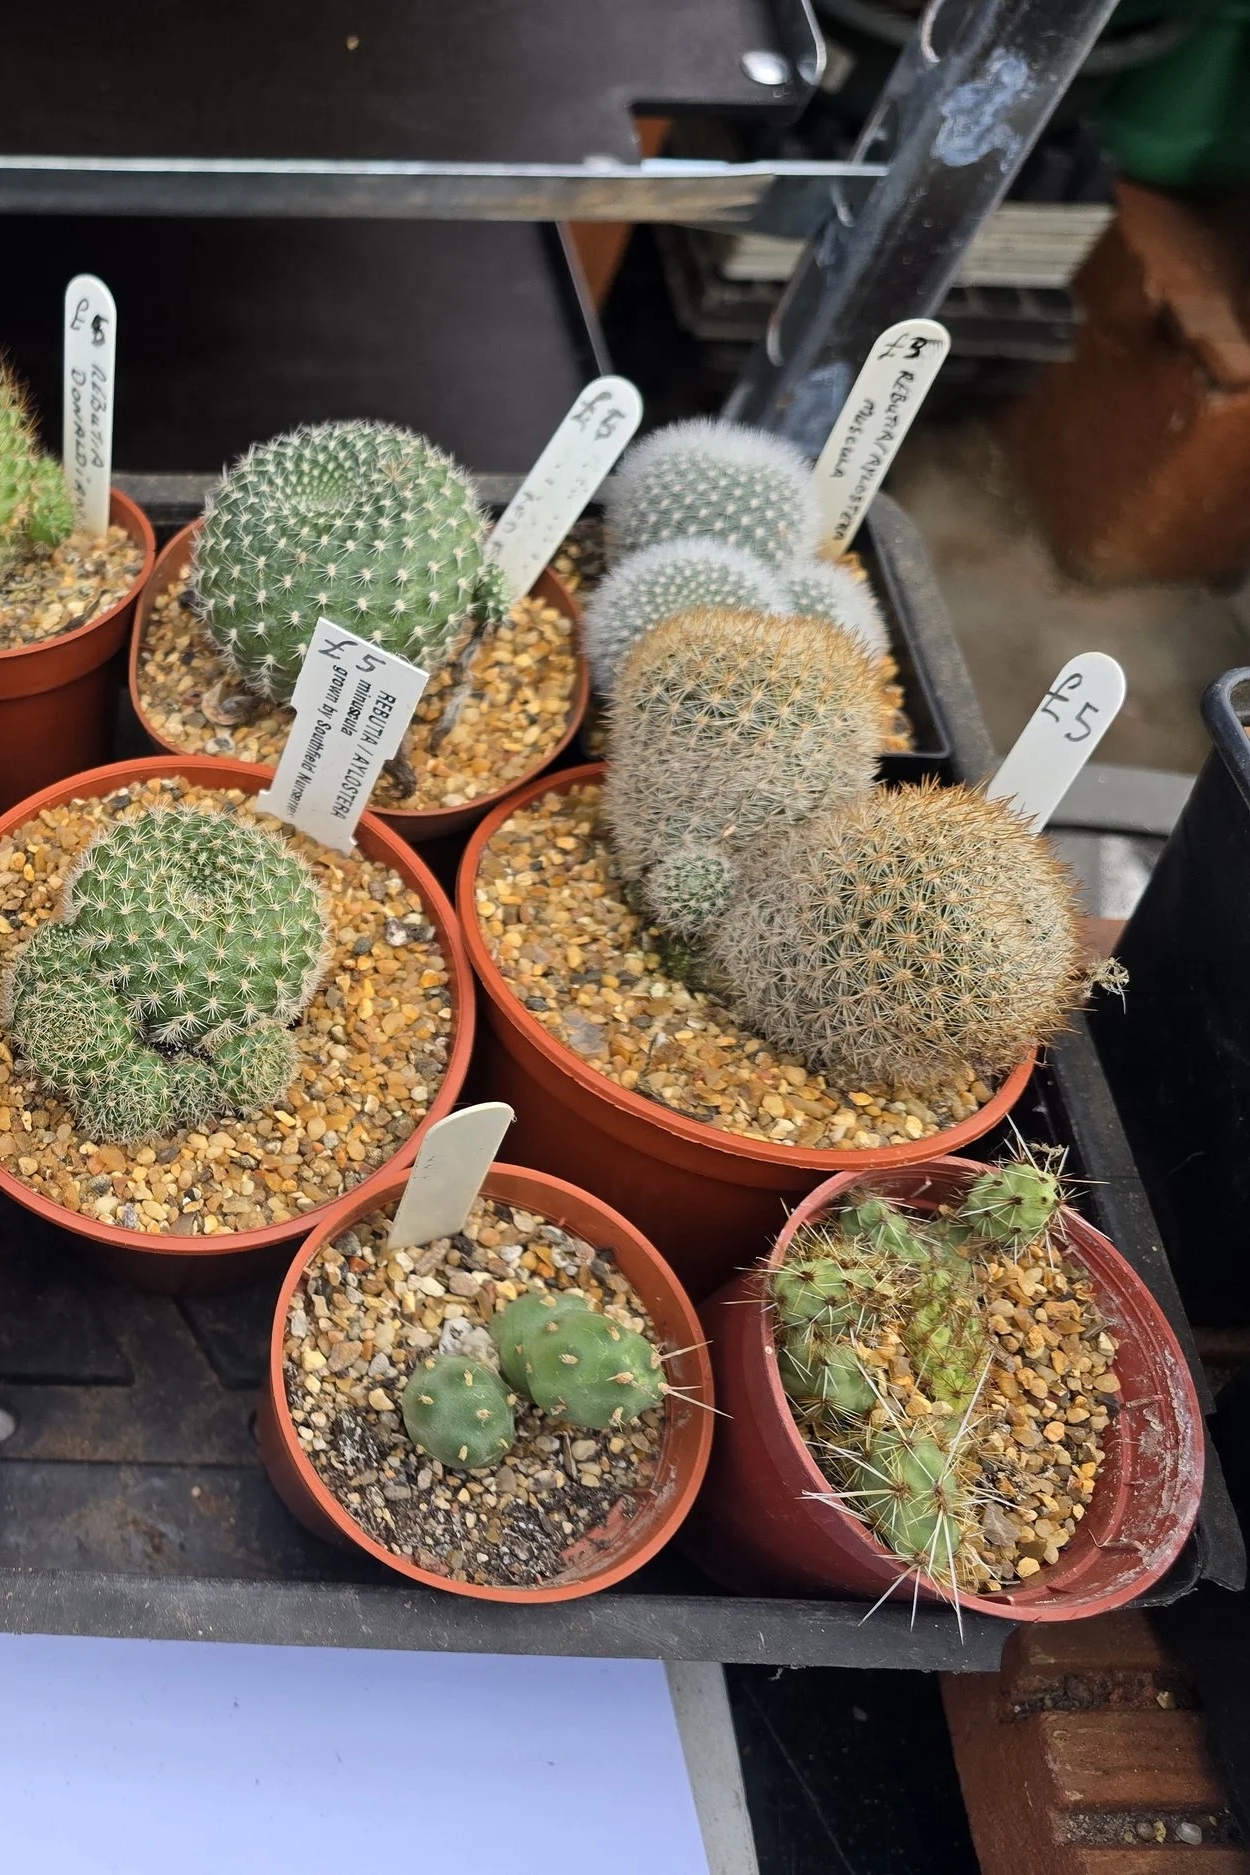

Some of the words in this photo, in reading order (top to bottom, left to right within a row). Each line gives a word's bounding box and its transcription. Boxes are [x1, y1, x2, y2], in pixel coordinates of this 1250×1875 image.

[571, 391, 626, 441] £5
[318, 638, 387, 673] £5
[317, 703, 337, 720] by
[326, 664, 349, 704] grown
[340, 679, 372, 737] minuscula
[1041, 673, 1099, 742] £5
[360, 690, 397, 746] REBUTIA
[301, 719, 332, 774] Southfield
[330, 752, 370, 820] AYLOSTERA
